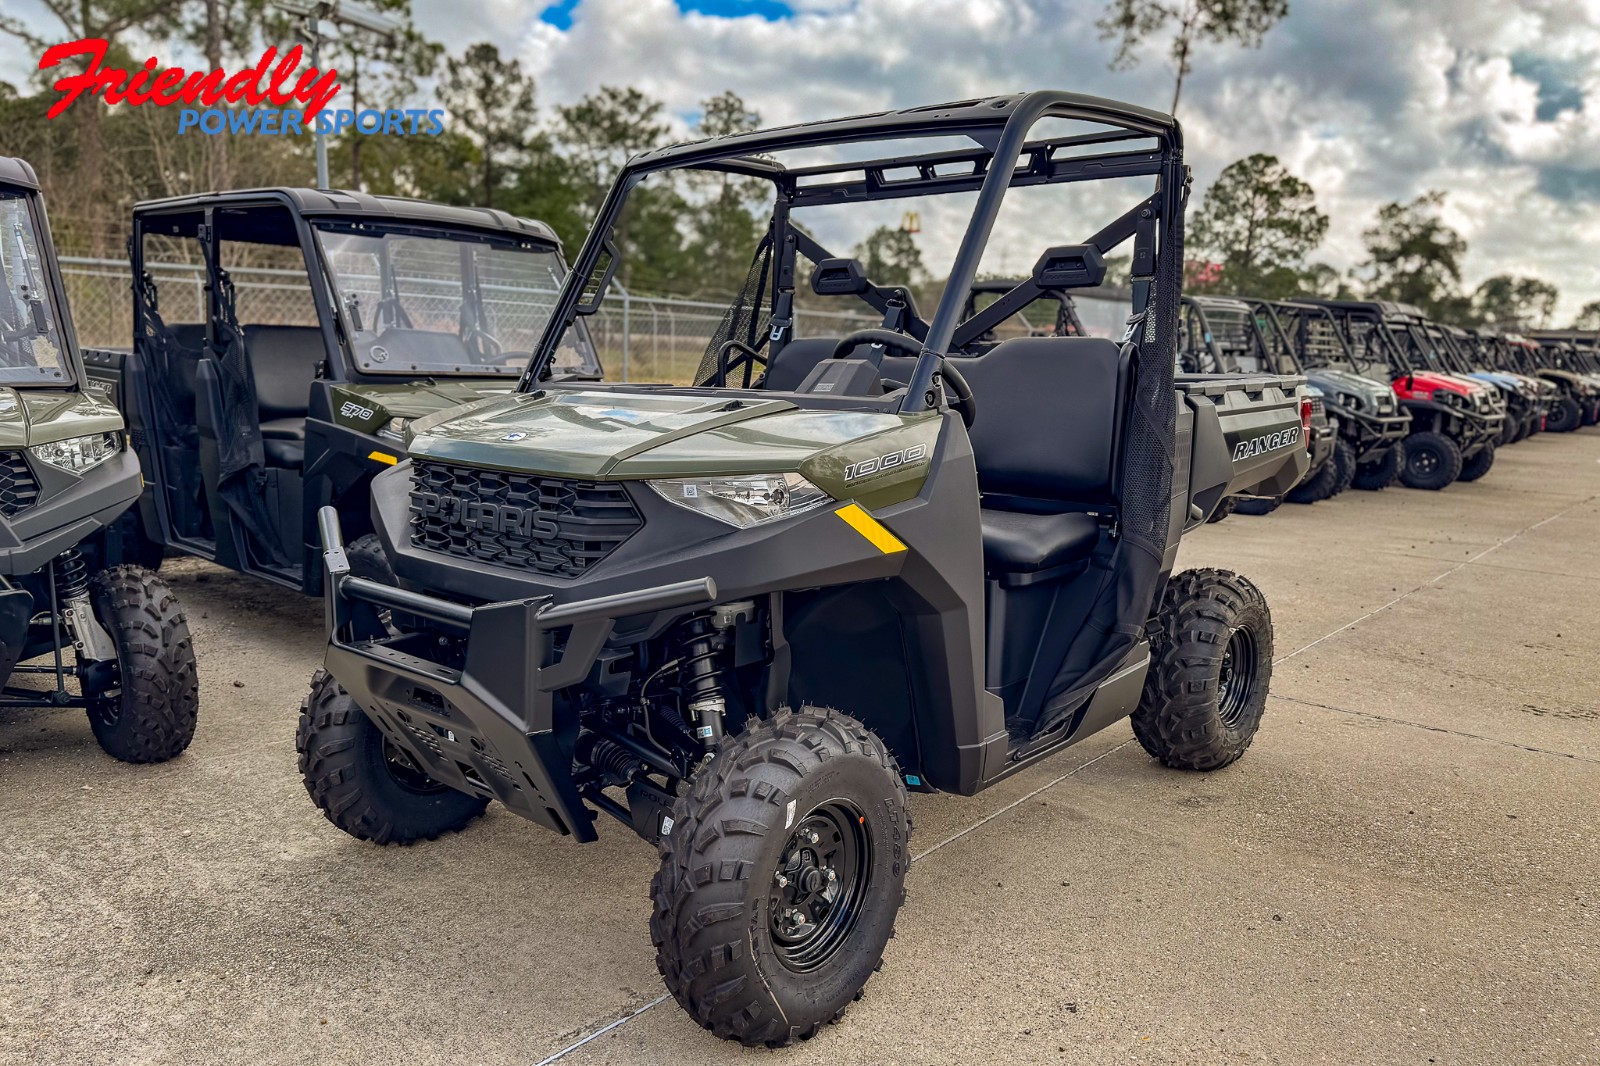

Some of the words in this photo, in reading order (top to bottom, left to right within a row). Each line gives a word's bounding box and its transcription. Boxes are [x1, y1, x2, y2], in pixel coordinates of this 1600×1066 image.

[340, 401, 375, 421] 570
[844, 442, 928, 482] 1000
[1232, 426, 1299, 462] RANGER
[421, 491, 560, 541] POLARIS
